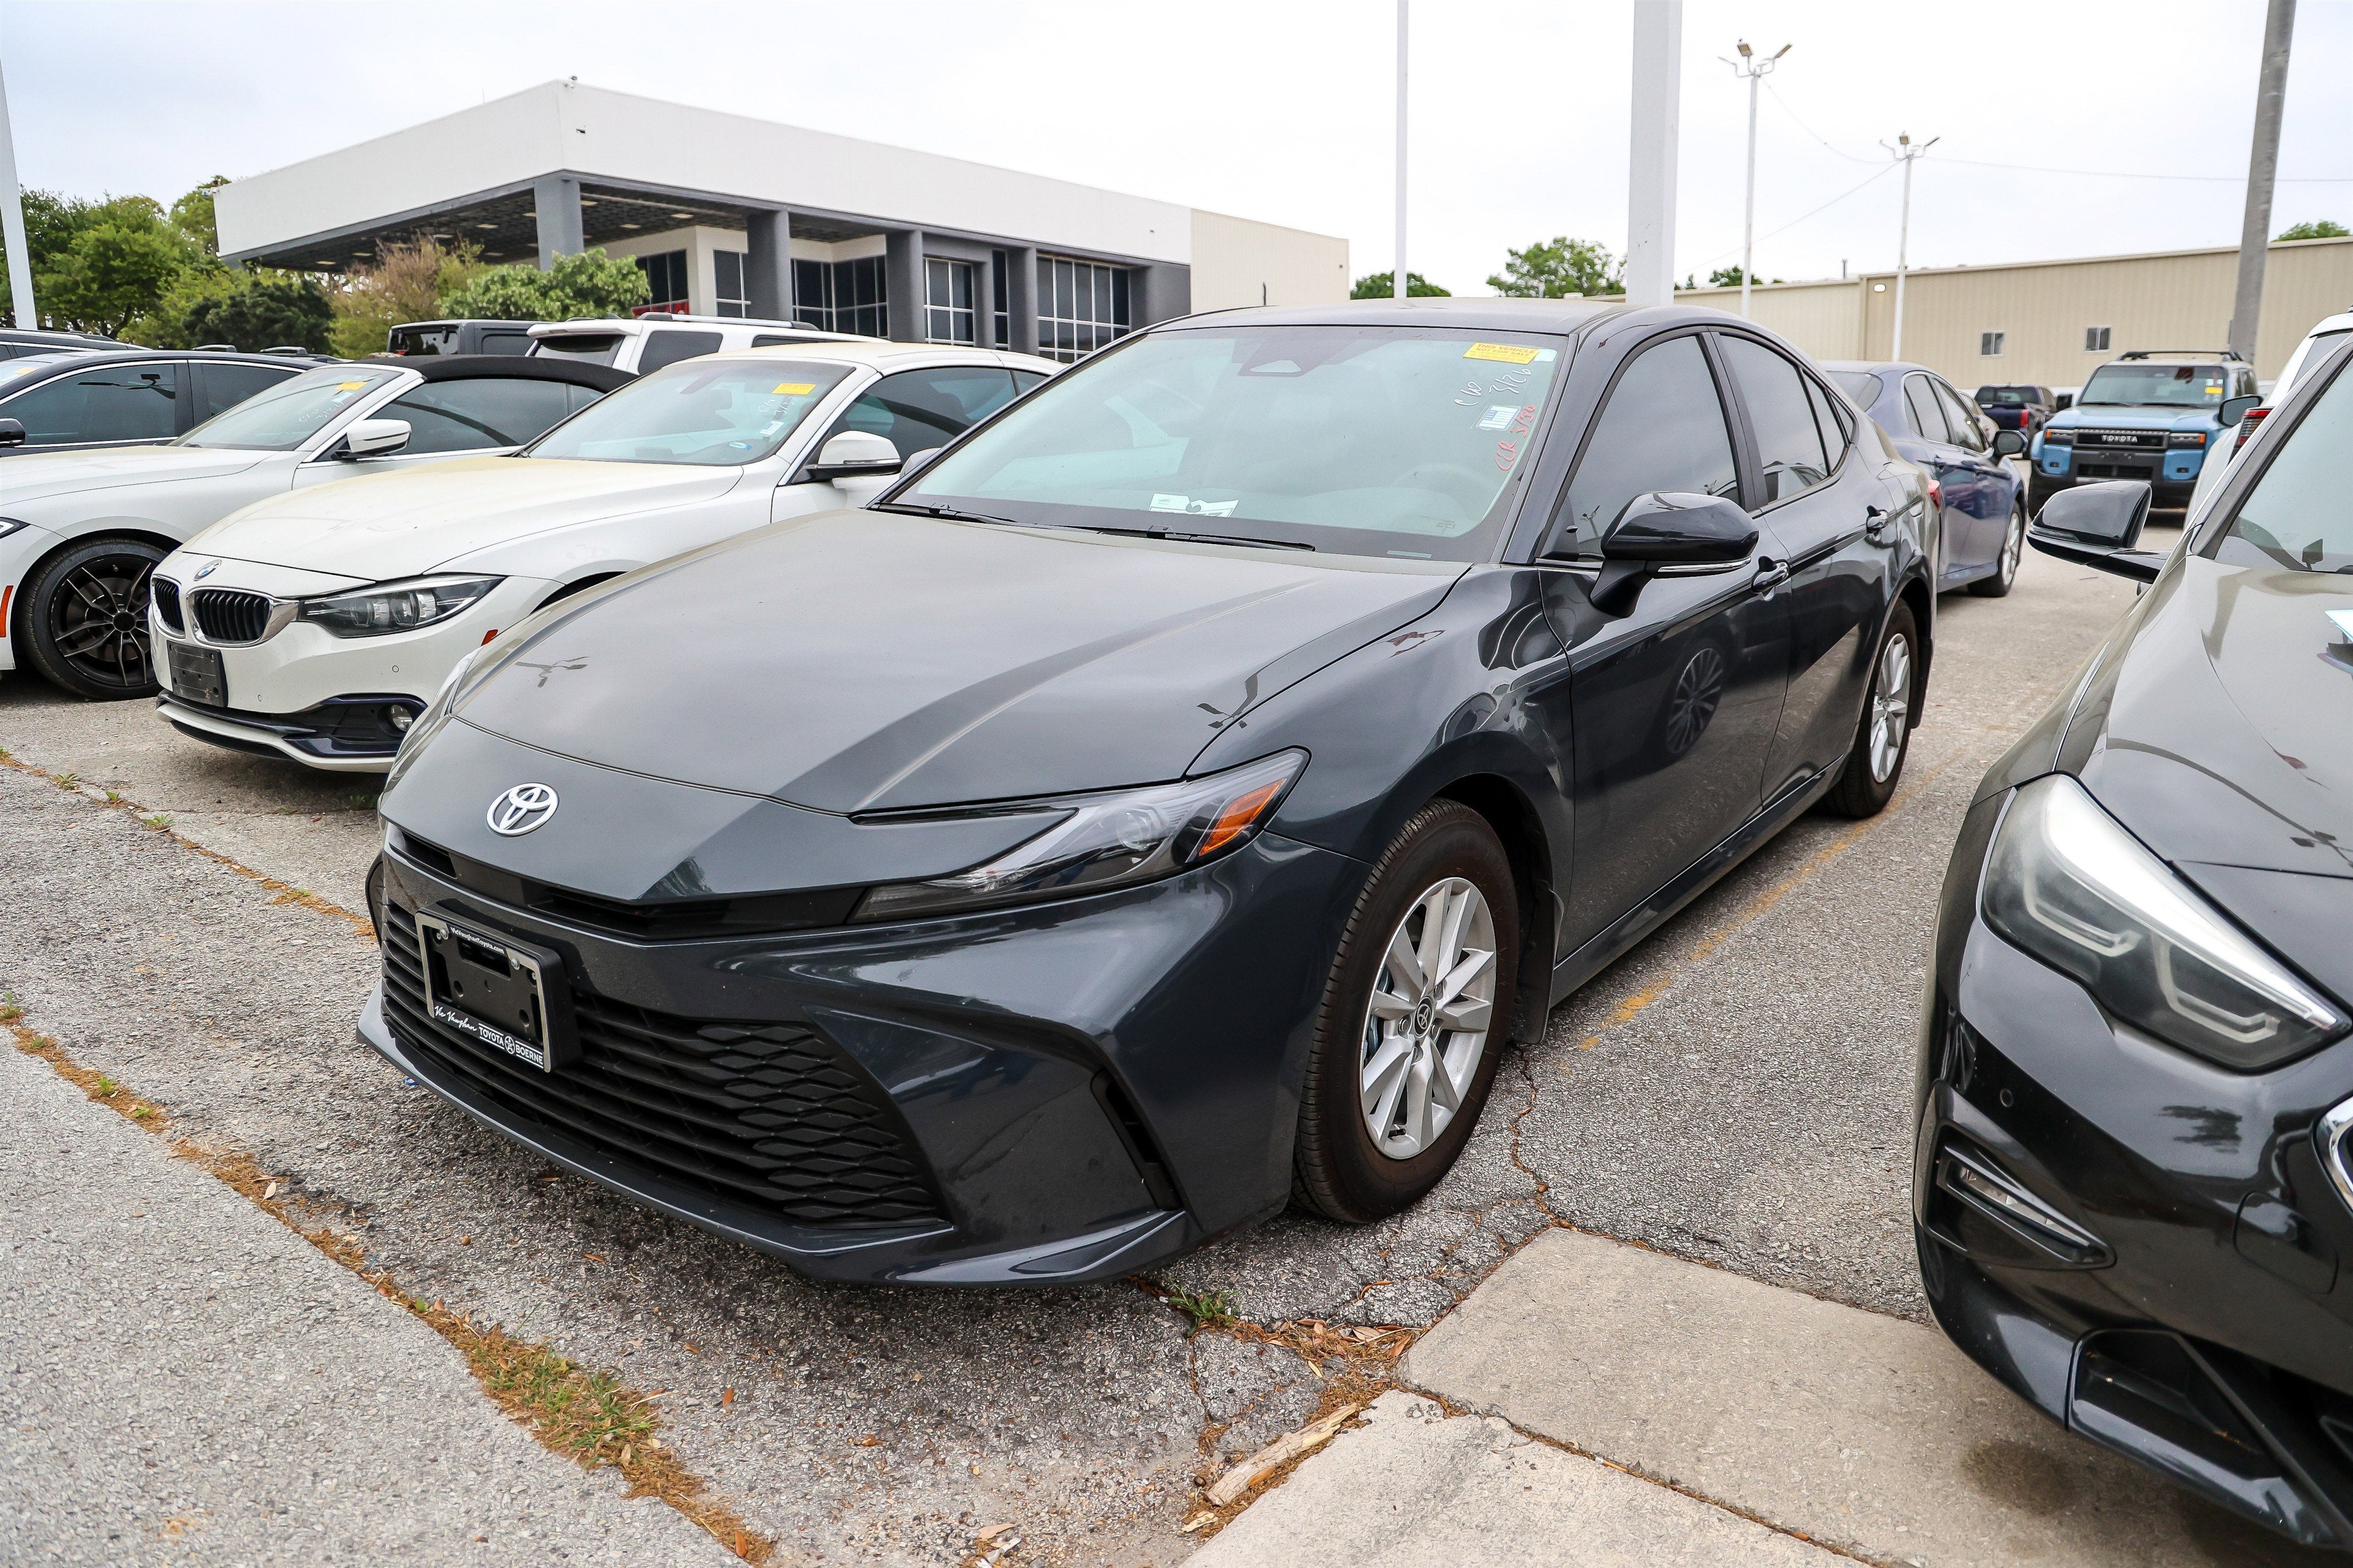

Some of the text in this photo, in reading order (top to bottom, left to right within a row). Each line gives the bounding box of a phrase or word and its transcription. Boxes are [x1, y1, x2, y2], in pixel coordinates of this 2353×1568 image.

[1499, 346, 1536, 354] VEHICLE
[2101, 435, 2138, 443] TOYOTA
[450, 926, 504, 954] VicVaughanToyota.com
[434, 1006, 446, 1017] Vic
[447, 1011, 477, 1031] Vaughan
[479, 1027, 504, 1046] TOYOTA
[515, 1044, 543, 1065] BOERNE
